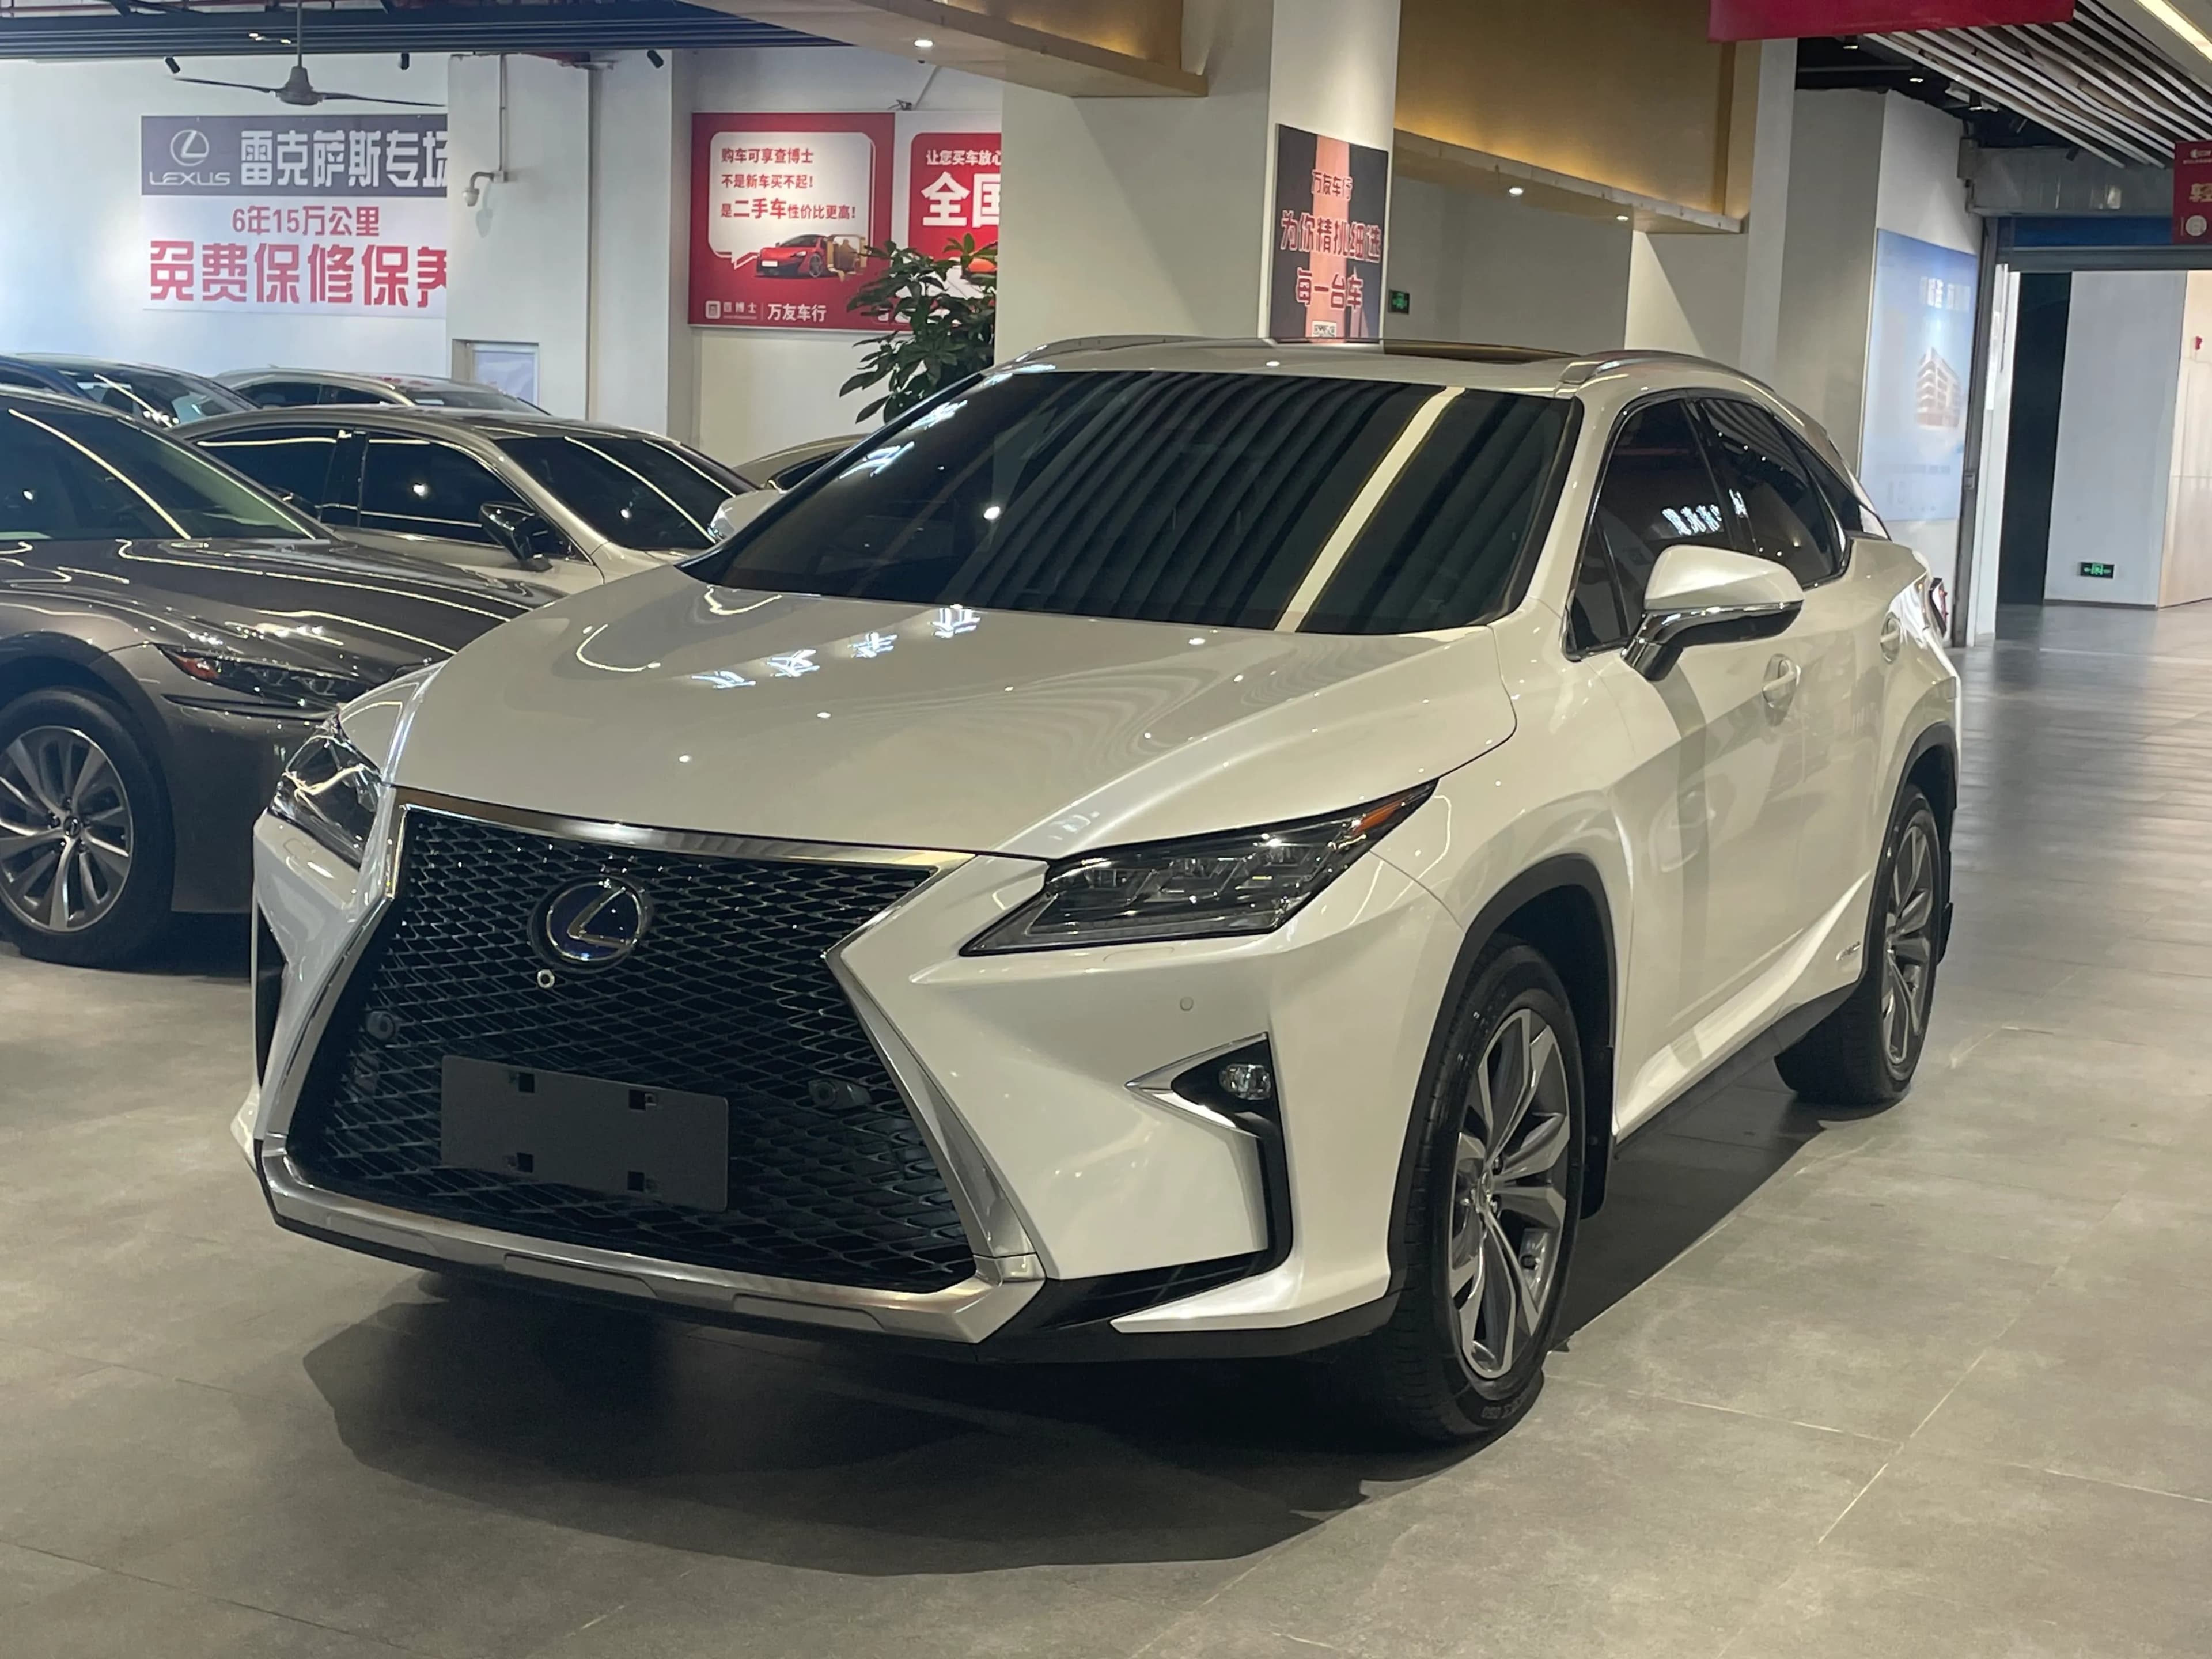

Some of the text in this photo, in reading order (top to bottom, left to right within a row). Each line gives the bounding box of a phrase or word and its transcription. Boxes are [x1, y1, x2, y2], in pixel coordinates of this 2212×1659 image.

[721, 148, 814, 164] 购车可享查博士
[149, 172, 230, 186] LEXUS
[721, 174, 813, 189] 不是新车买不起！
[1311, 169, 1353, 202] 万友车行
[721, 198, 856, 219] 是二手车性价比更高！
[232, 206, 379, 236] 6年15万公里
[1281, 210, 1381, 263] 为你精挑细选
[1296, 267, 1363, 310] 每一台车
[767, 303, 827, 322] 万友车行
